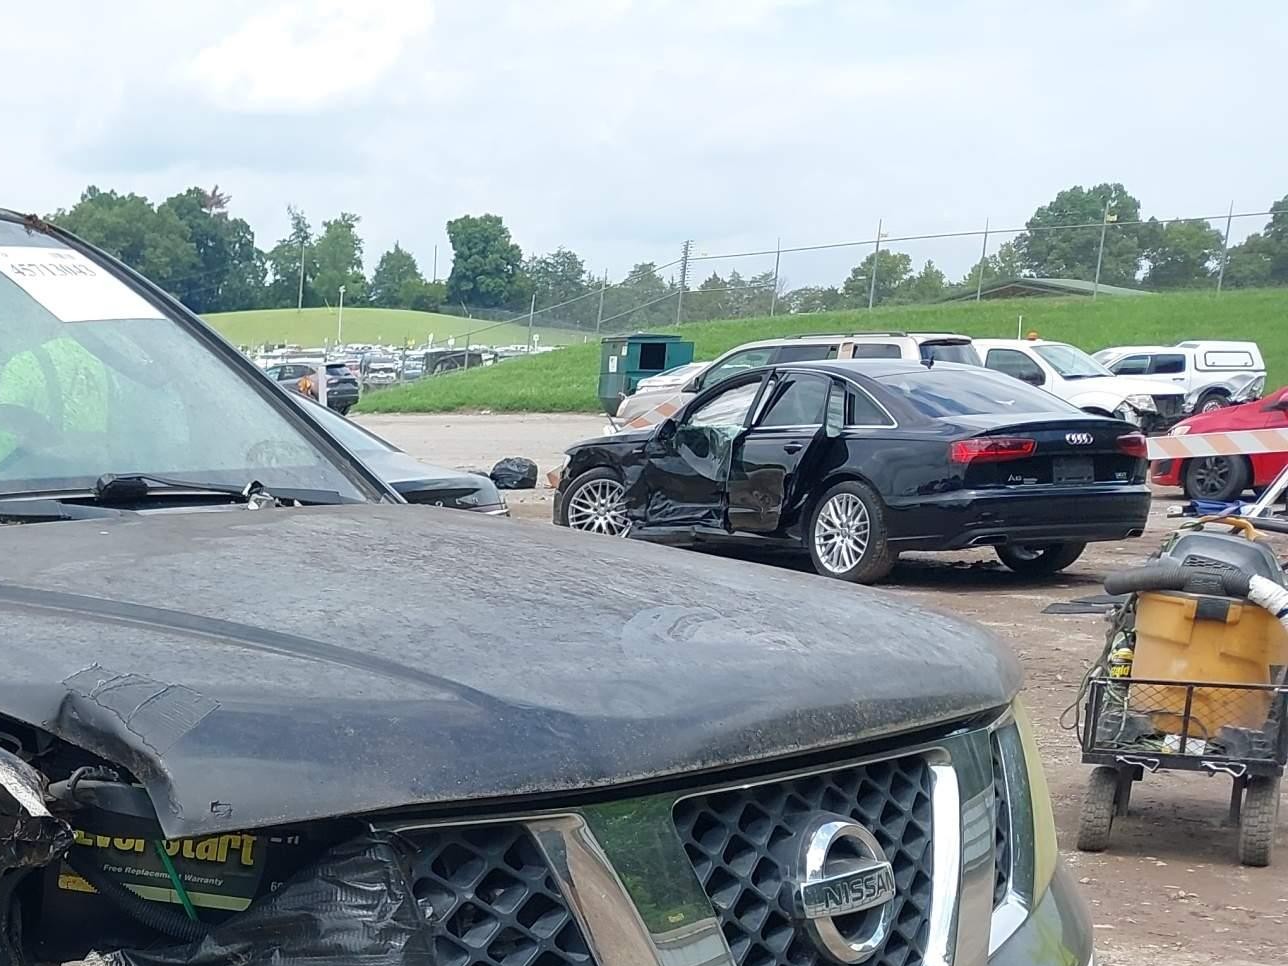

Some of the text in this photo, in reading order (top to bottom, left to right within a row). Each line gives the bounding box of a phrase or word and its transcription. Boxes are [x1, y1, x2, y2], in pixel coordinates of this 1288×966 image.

[103, 863, 123, 874] Free
[184, 873, 224, 887] Warranty
[823, 870, 895, 909] NISSAN
